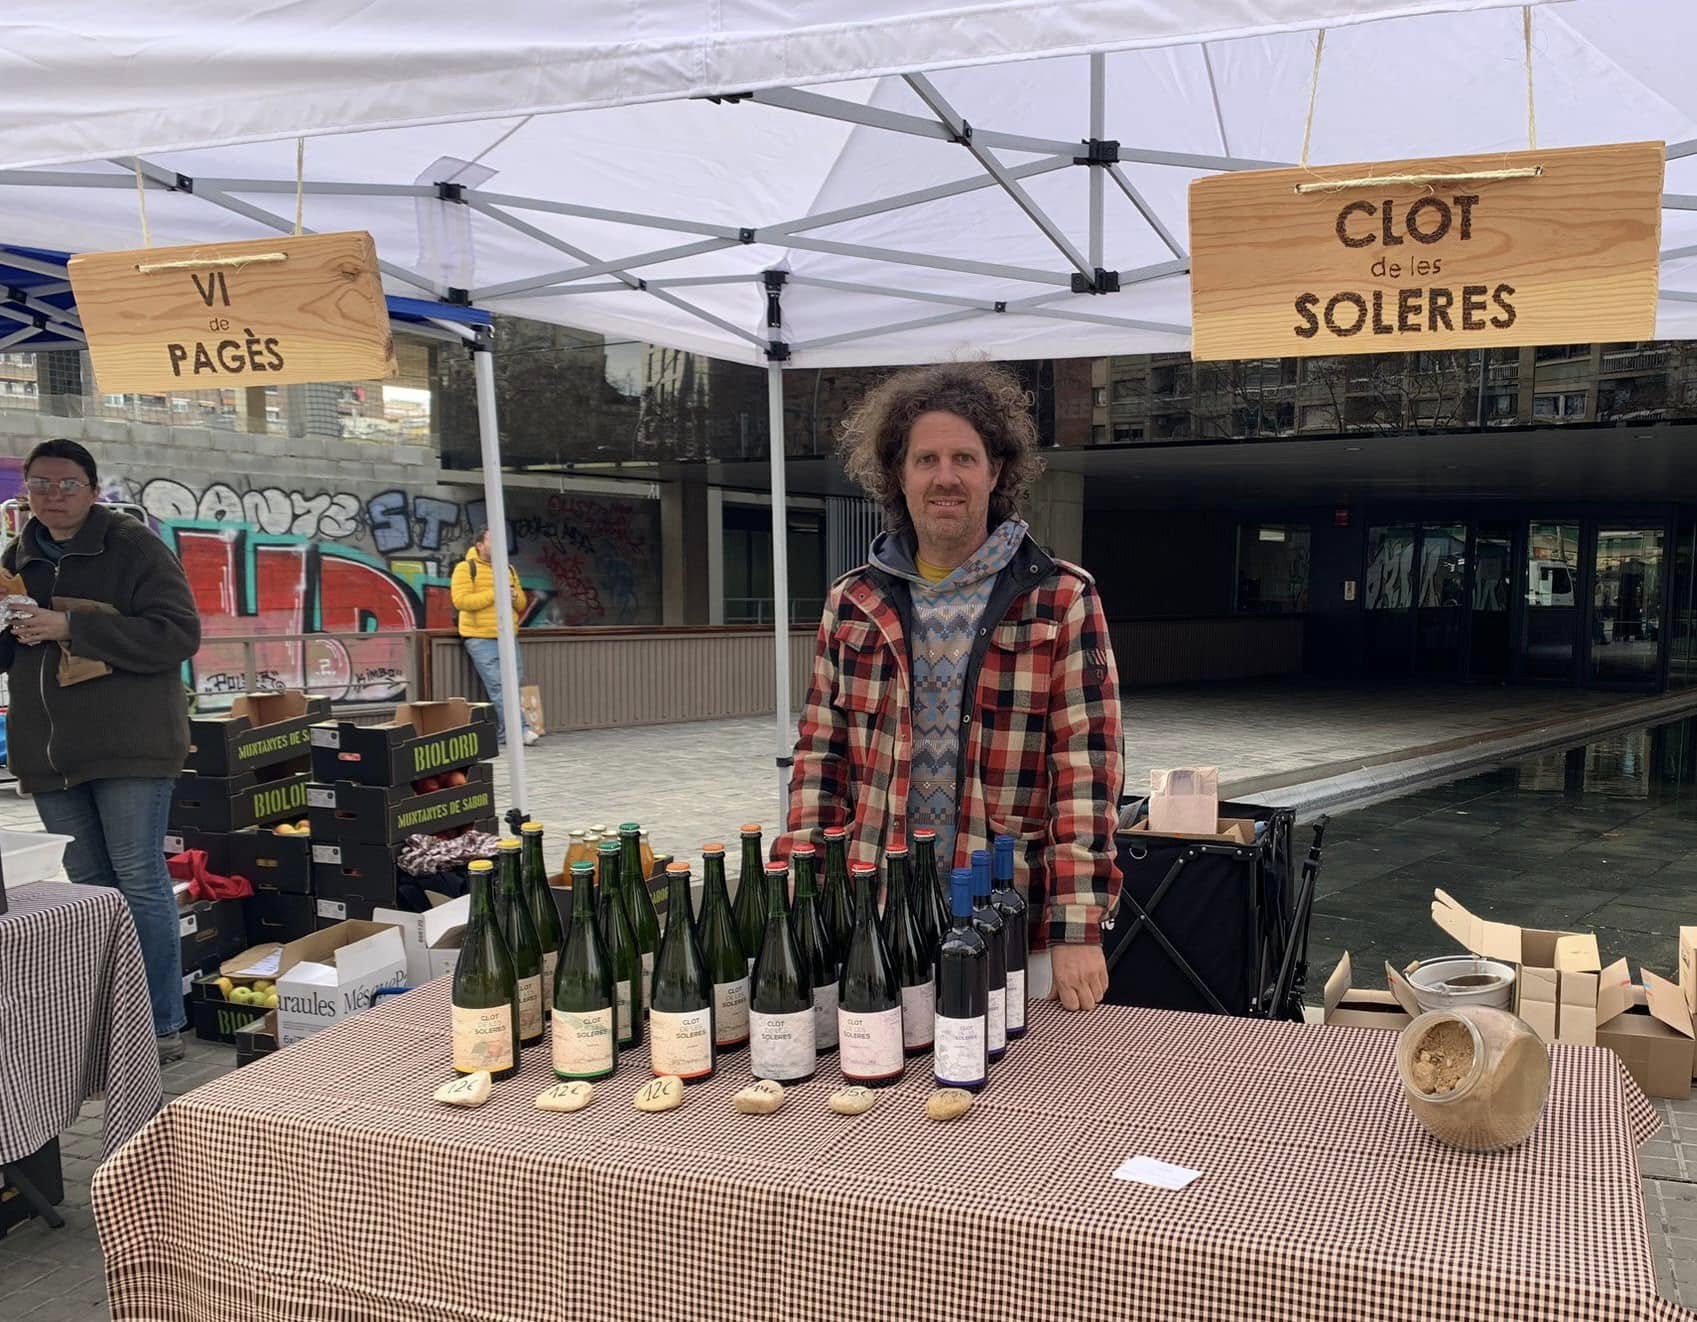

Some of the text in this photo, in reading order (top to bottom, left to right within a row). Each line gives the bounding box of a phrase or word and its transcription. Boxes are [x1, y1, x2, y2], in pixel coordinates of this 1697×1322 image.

[1336, 194, 1480, 249] CLOT
[1371, 255, 1442, 278] de les
[191, 271, 231, 307] VI
[1294, 283, 1517, 339] SOLERES
[209, 317, 230, 332] de
[167, 328, 284, 377] PAGÈS
[289, 730, 302, 746] DE
[414, 732, 479, 772] BIOLORD
[449, 800, 461, 815] DE
[728, 986, 742, 994] CLOT
[480, 1013, 499, 1021] CLOT
[583, 1016, 602, 1025] CLOT
[474, 1025, 506, 1034] SOLERES
[676, 1030, 706, 1039] SOLERES
[843, 1031, 870, 1039] SOLERES
